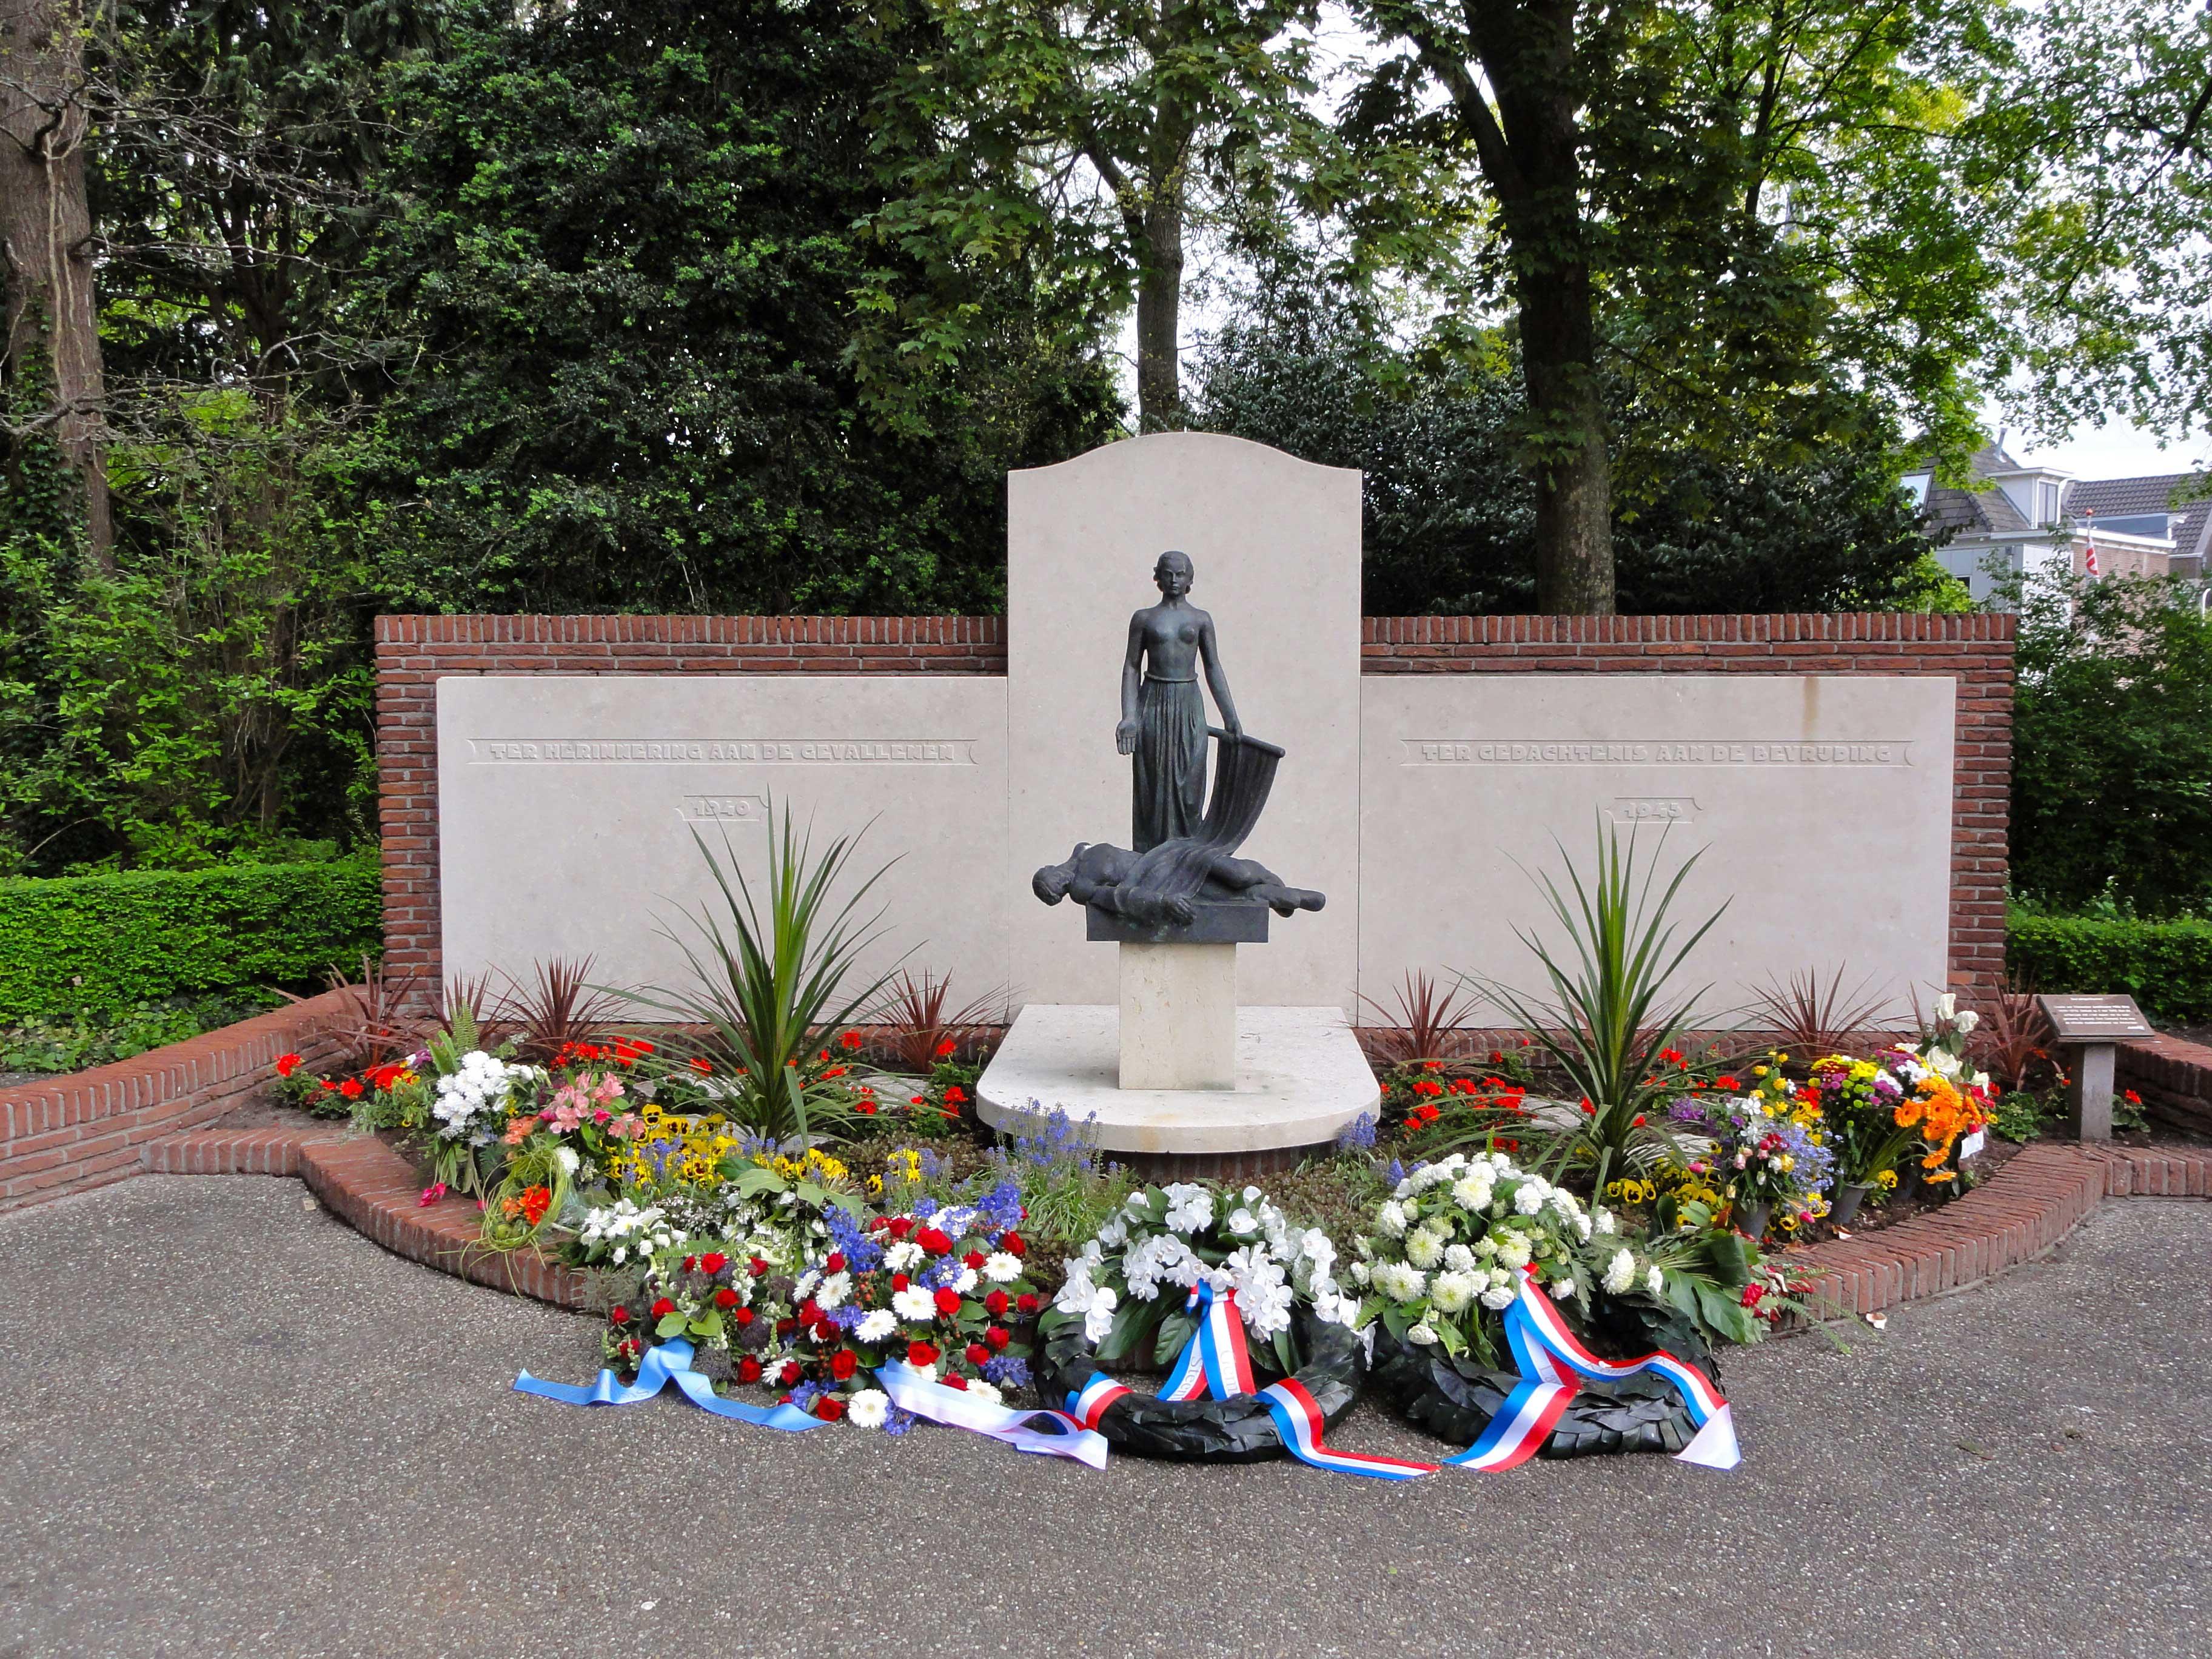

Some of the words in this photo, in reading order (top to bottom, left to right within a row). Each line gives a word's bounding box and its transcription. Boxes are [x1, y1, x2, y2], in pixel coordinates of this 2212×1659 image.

[490, 743, 537, 759] TER
[545, 743, 702, 760] HERINNERING
[708, 744, 756, 760] AAN
[762, 744, 793, 760] DE
[800, 744, 954, 760] GEVALLENEN
[1422, 745, 1470, 760] TER
[1478, 745, 1648, 761] GEDACHTENIS
[1655, 745, 1706, 762] AAN
[1712, 746, 1745, 762] DE
[694, 800, 750, 816] 1940
[1624, 802, 1683, 818] 1945
